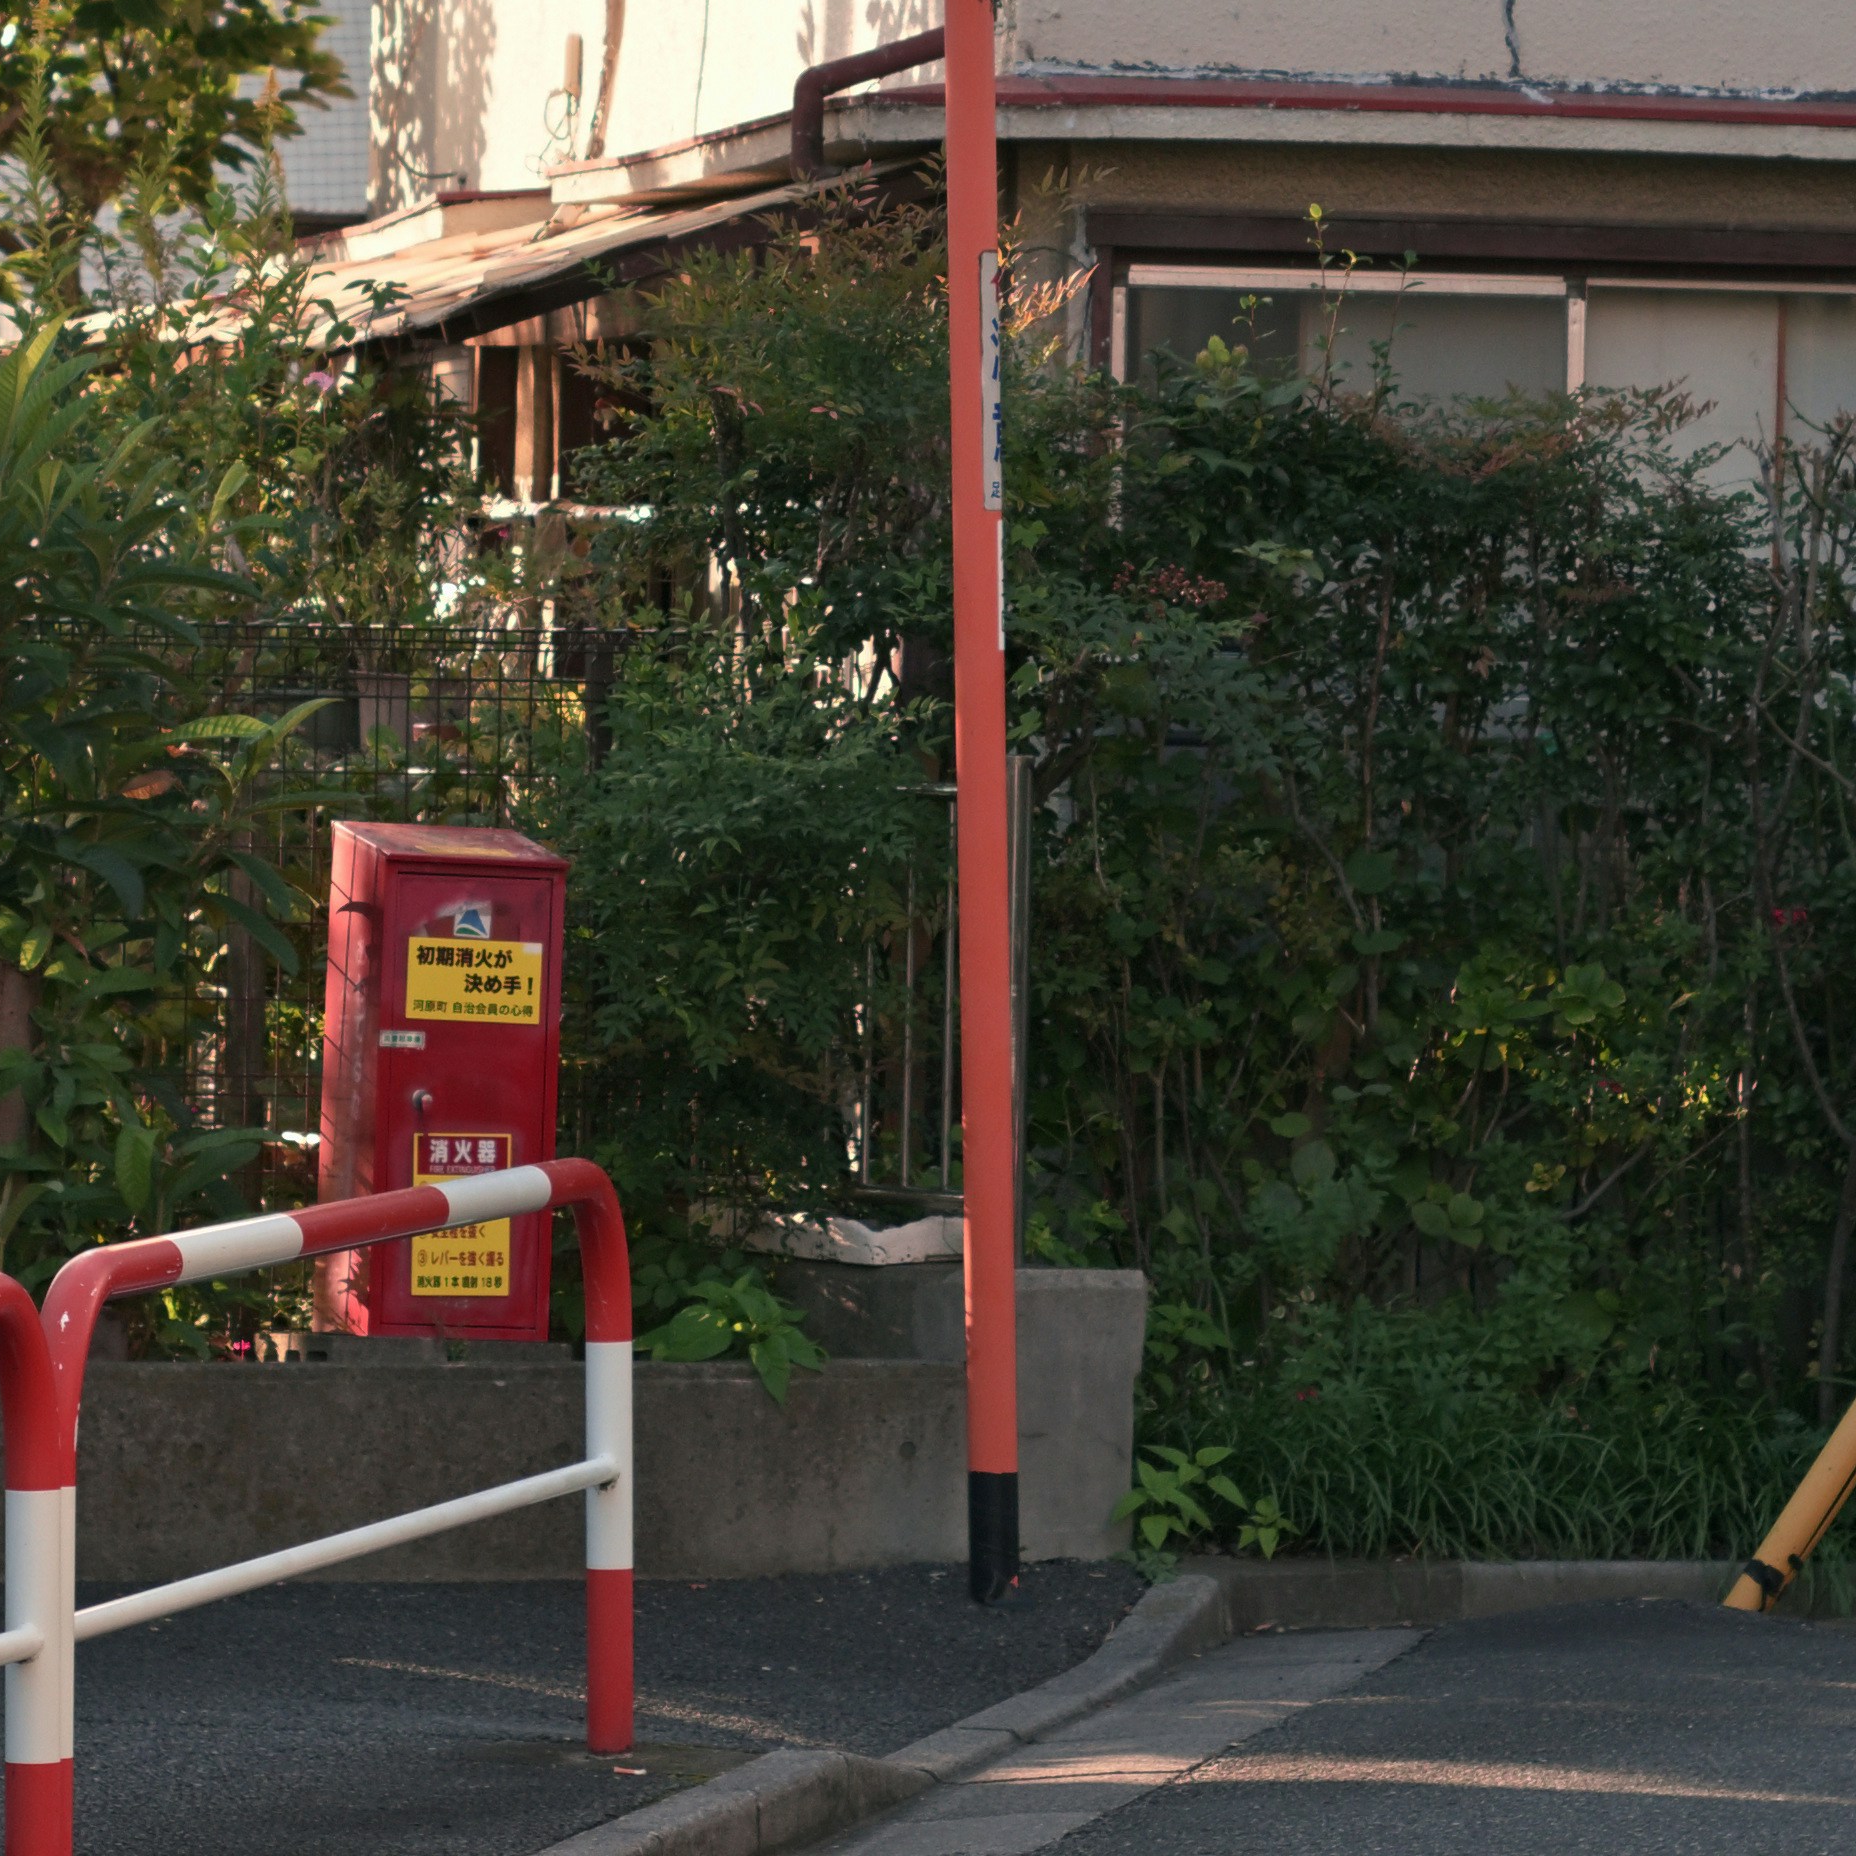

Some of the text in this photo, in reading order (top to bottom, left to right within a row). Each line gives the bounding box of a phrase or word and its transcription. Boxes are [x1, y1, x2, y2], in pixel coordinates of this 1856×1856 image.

[416, 945, 513, 969] 初期消火が
[464, 973, 534, 996] 決め手！
[413, 999, 534, 1018] 河原町 自治会員の心得
[429, 1138, 496, 1164] 消火器
